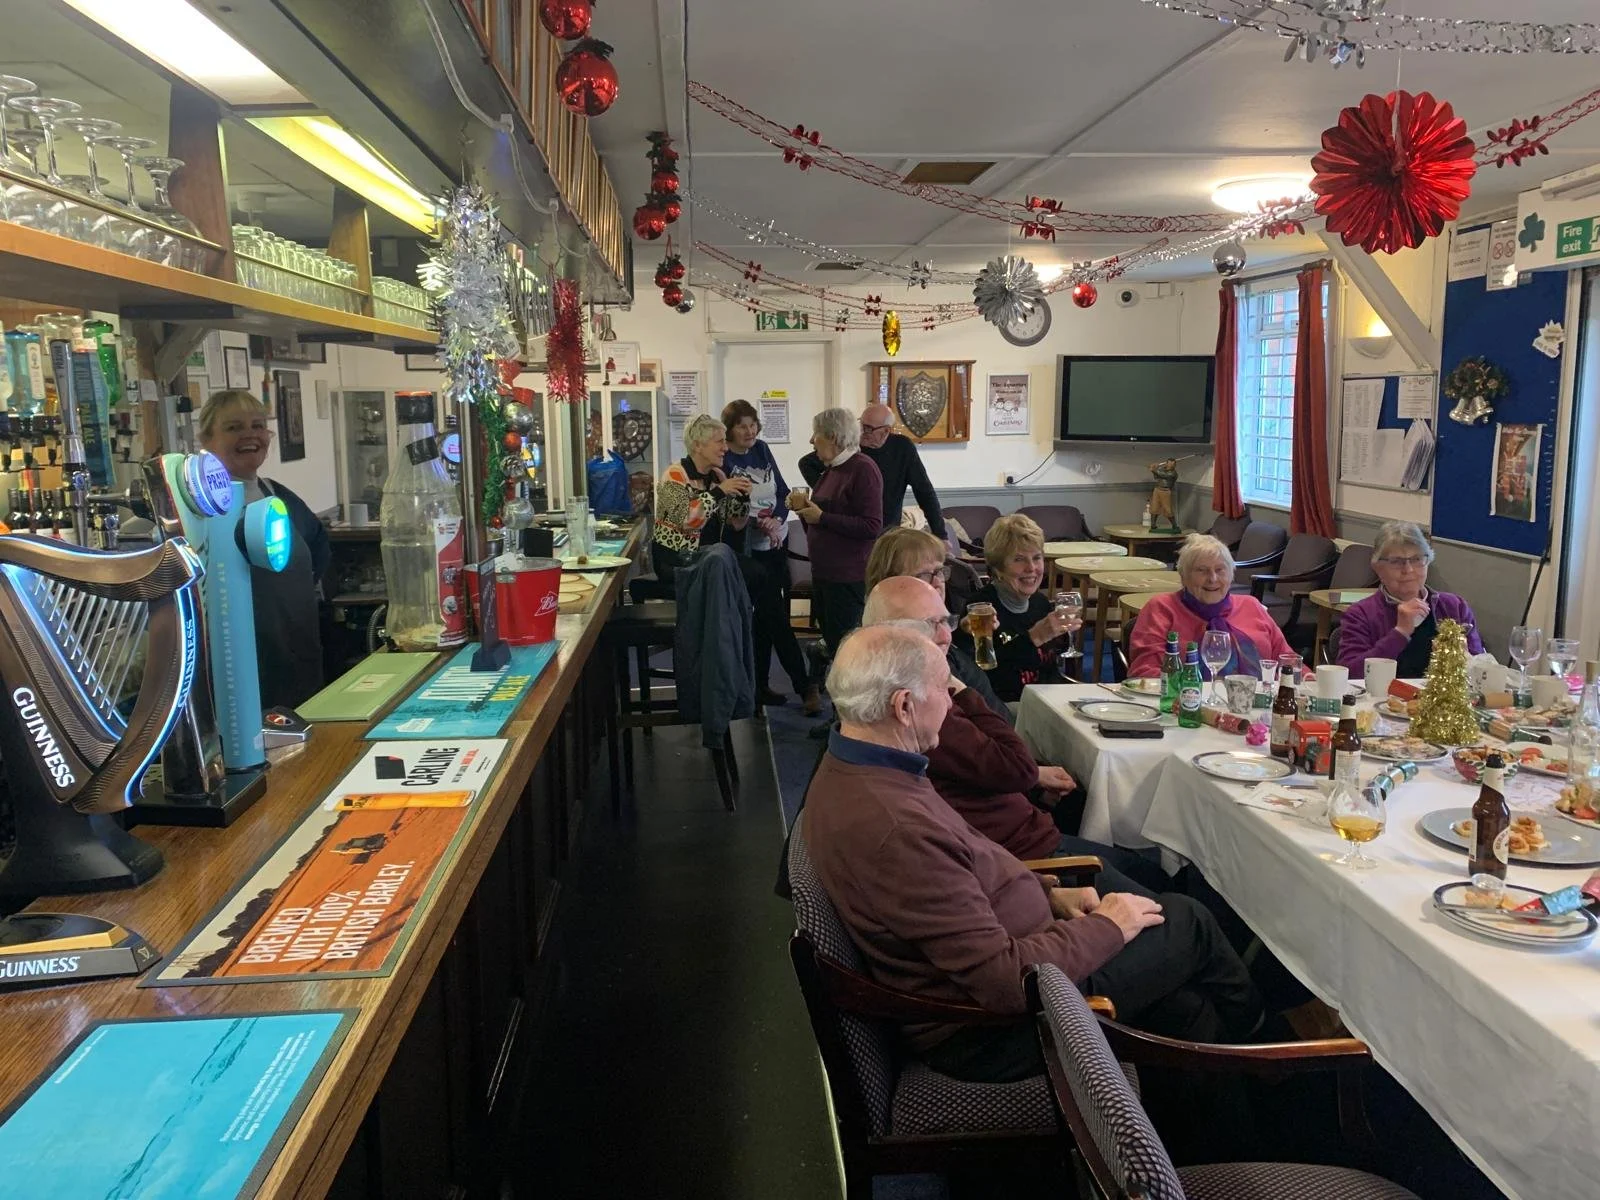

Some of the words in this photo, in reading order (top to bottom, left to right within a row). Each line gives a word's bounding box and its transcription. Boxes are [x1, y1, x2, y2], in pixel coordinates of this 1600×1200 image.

[1562, 225, 1583, 239] Fire
[1562, 240, 1581, 253] exit
[79, 403, 91, 423] PALE
[83, 425, 96, 444] ALE
[179, 619, 195, 708] GUINNESS
[13, 687, 76, 788] GUINNESS
[401, 747, 460, 787] CARLING
[279, 926, 326, 963] WITH
[315, 890, 362, 923] 100%
[321, 914, 385, 960] BRITISH
[362, 860, 417, 914] BARLEY.
[238, 907, 312, 964] BREWED
